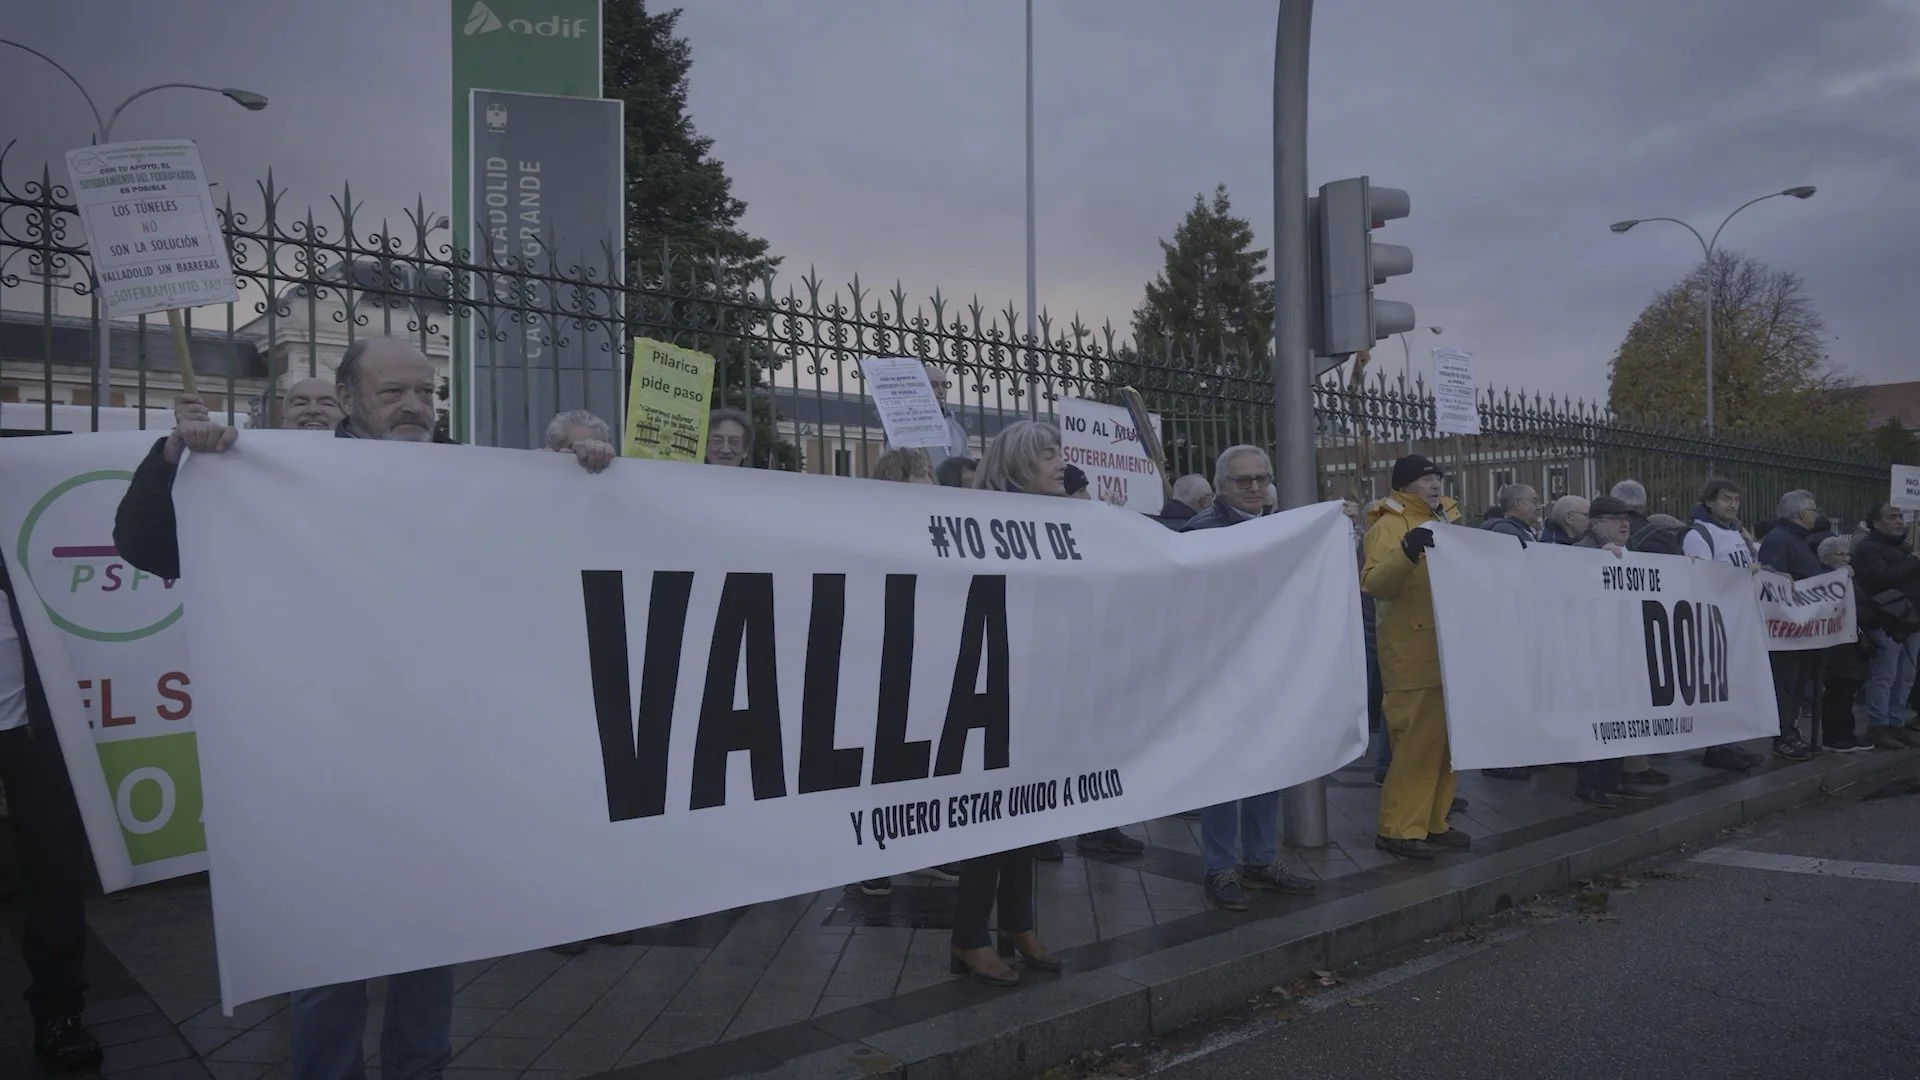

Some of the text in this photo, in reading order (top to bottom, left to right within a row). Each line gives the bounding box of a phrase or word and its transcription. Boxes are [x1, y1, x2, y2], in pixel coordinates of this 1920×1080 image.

[507, 15, 590, 38] adif
[99, 167, 117, 175] CON
[118, 165, 128, 173] TU
[112, 200, 178, 217] LOS TÚNELES
[519, 160, 541, 257] GRANDE
[142, 221, 158, 233] NO
[110, 235, 199, 257] SON LA SOLUCIÓN
[101, 259, 220, 283] VALLADOLID SIN BARRERAS
[652, 350, 698, 375] Pilarica
[641, 376, 703, 403] pide paso
[1065, 415, 1086, 432] NO
[1092, 421, 1109, 437] AL
[1063, 446, 1154, 475] SOTERRAMIENTO
[1906, 478, 1919, 486] NO
[1906, 488, 1920, 496] MU
[928, 515, 1082, 561] #YO SOY DE
[1602, 566, 1661, 592] #YO SOY DE
[1792, 581, 1846, 608] MURO
[1641, 600, 1729, 707] DOLID
[581, 570, 1009, 822] VALLA
[1592, 722, 1599, 741] Y
[1600, 721, 1627, 745] QUIERO
[1627, 719, 1651, 739] ESTAR
[1652, 717, 1674, 737] UNIDO
[850, 768, 1124, 850] Y QUIERO ESTAR UNIDO A DOLID
